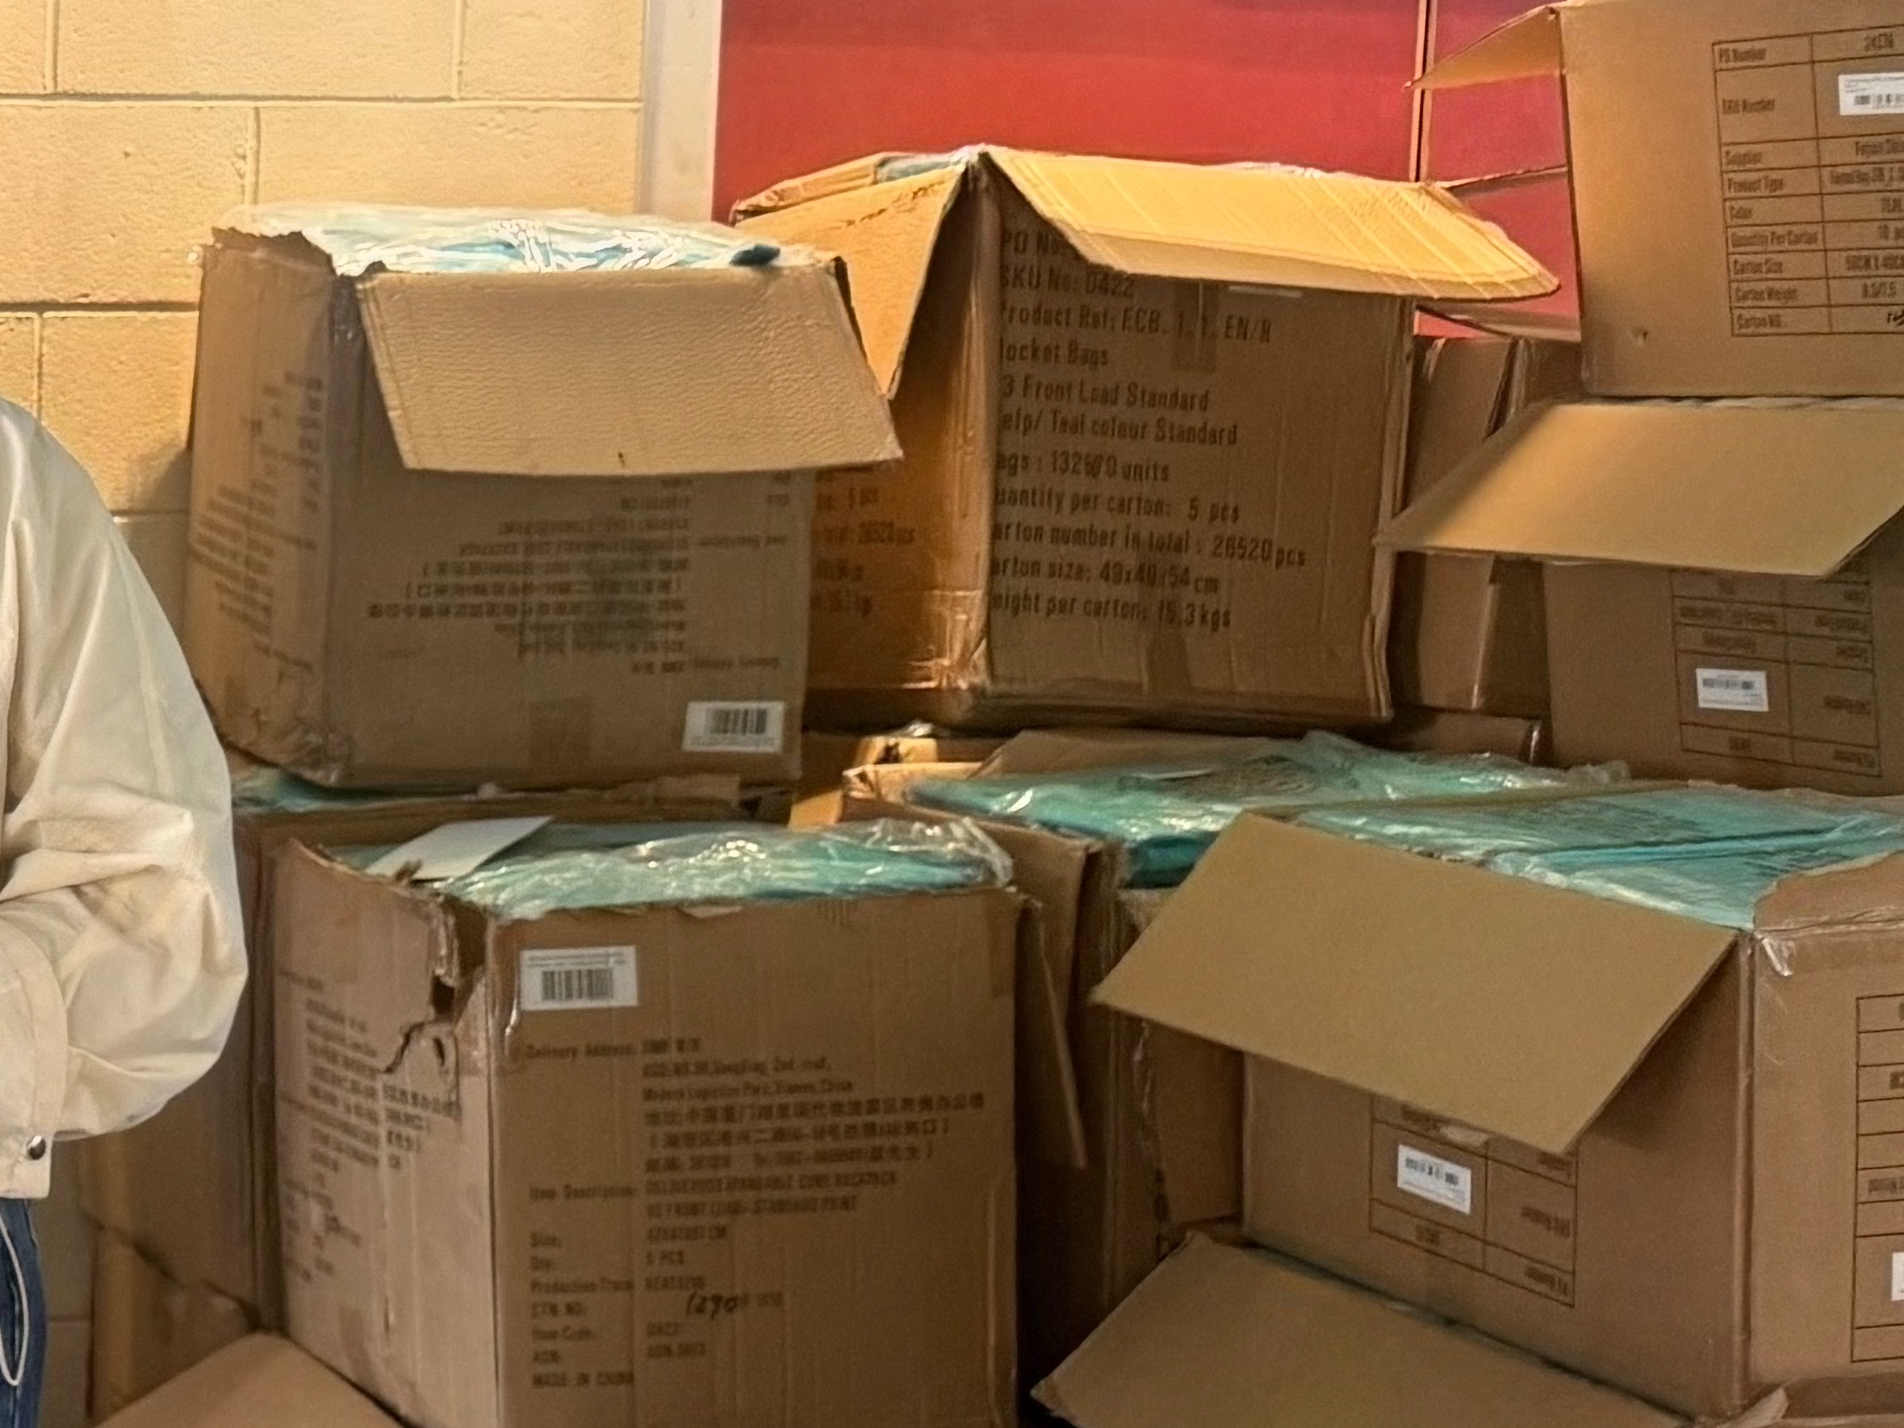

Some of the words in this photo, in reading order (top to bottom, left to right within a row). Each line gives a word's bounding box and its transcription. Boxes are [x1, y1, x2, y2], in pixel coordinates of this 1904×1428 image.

[999, 336, 1061, 362] ocket
[1068, 341, 1109, 370] Bags
[1023, 375, 1073, 400] Front
[1078, 377, 1120, 406] Load
[1126, 381, 1210, 413] Standard
[1050, 410, 1085, 436] Teal
[1091, 415, 1147, 441] colour
[1155, 417, 1238, 447] Standard
[1121, 459, 1170, 483] units
[1071, 491, 1100, 515] per
[1209, 501, 1240, 524] pcs
[1050, 524, 1117, 548] number
[1125, 524, 1141, 551] in
[1275, 544, 1306, 570] pcs
[1046, 593, 1077, 619] per
[1198, 602, 1231, 633] kgs
